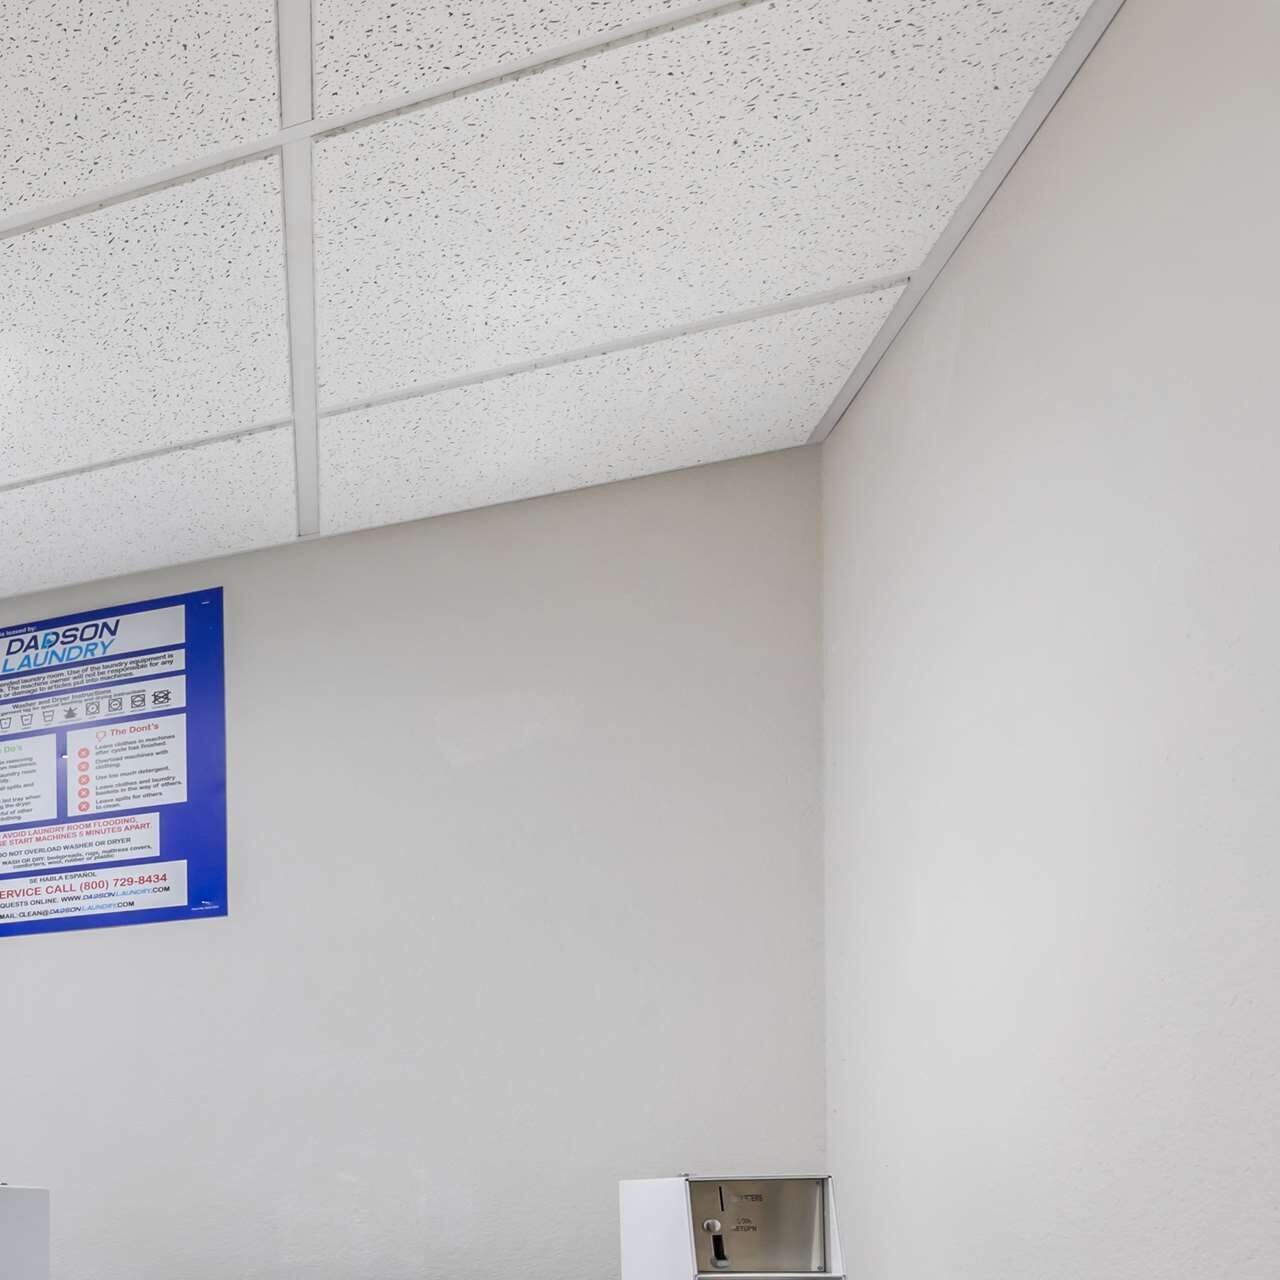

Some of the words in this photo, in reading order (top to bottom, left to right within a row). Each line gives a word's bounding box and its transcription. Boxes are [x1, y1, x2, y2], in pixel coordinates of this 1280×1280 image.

[6, 619, 120, 656] DADSON
[2, 639, 115, 673] LAUNDRY
[111, 727, 127, 736] The
[45, 883, 76, 895] CALL
[80, 879, 109, 892] (800)
[113, 873, 168, 887] 729-8434
